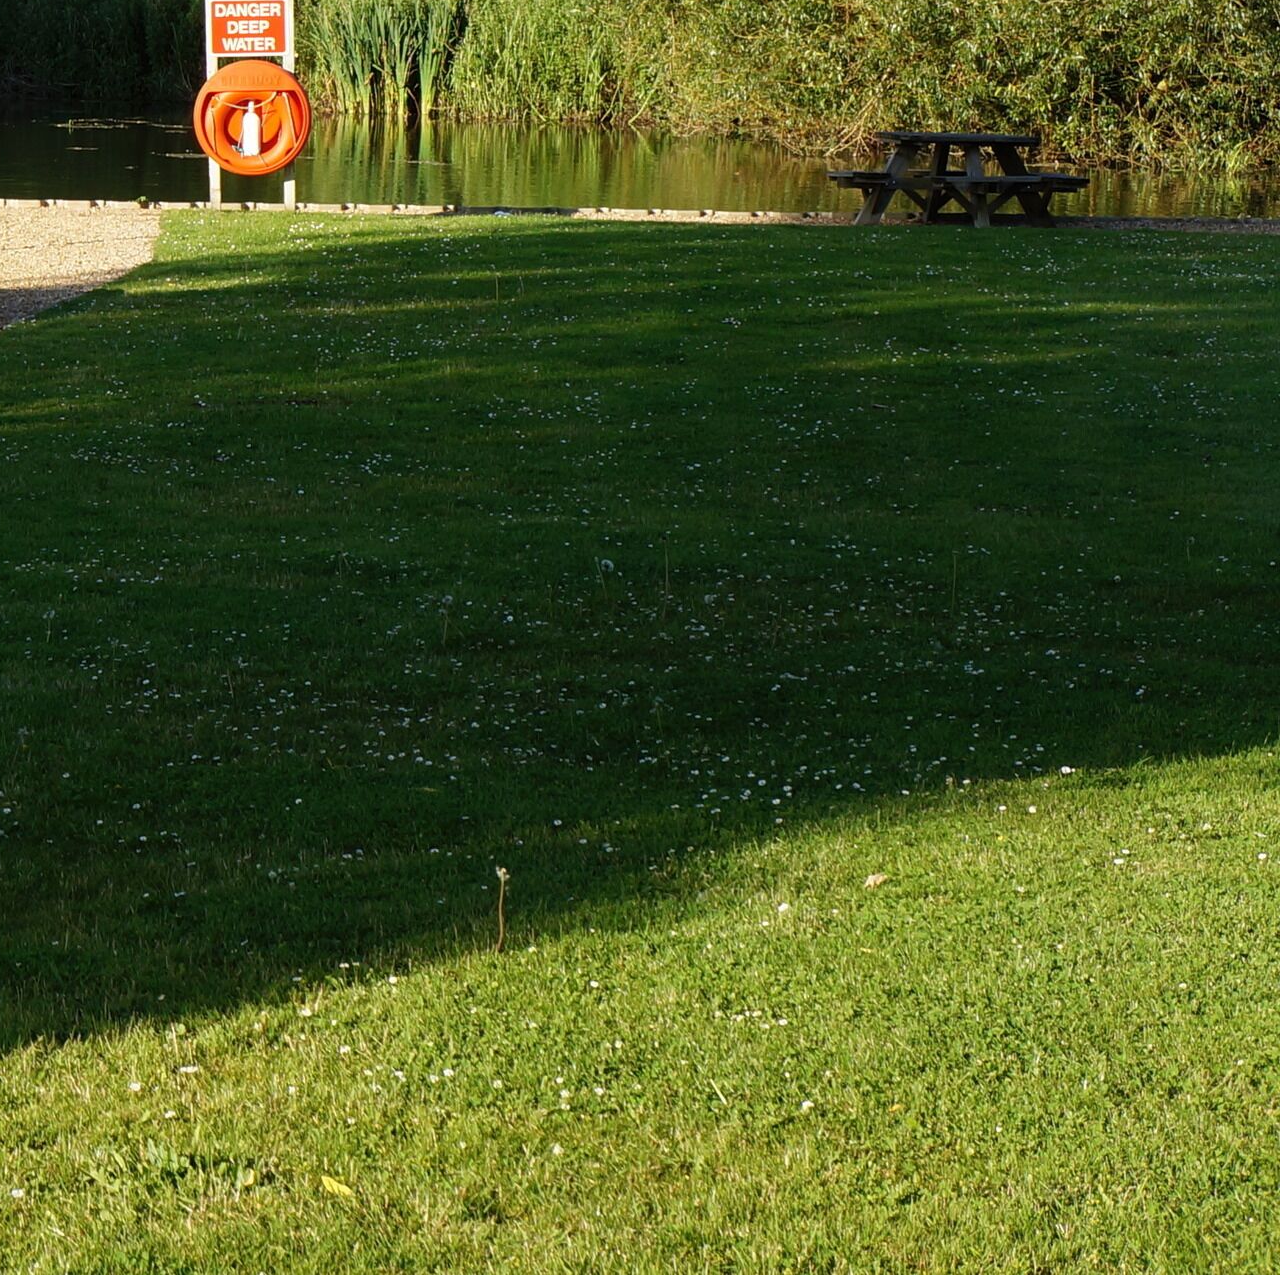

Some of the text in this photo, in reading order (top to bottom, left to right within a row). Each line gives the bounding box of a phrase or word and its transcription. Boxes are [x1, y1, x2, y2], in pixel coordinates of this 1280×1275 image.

[214, 3, 281, 17] DANGER
[227, 20, 269, 34] DEEP
[222, 37, 276, 51] WATER
